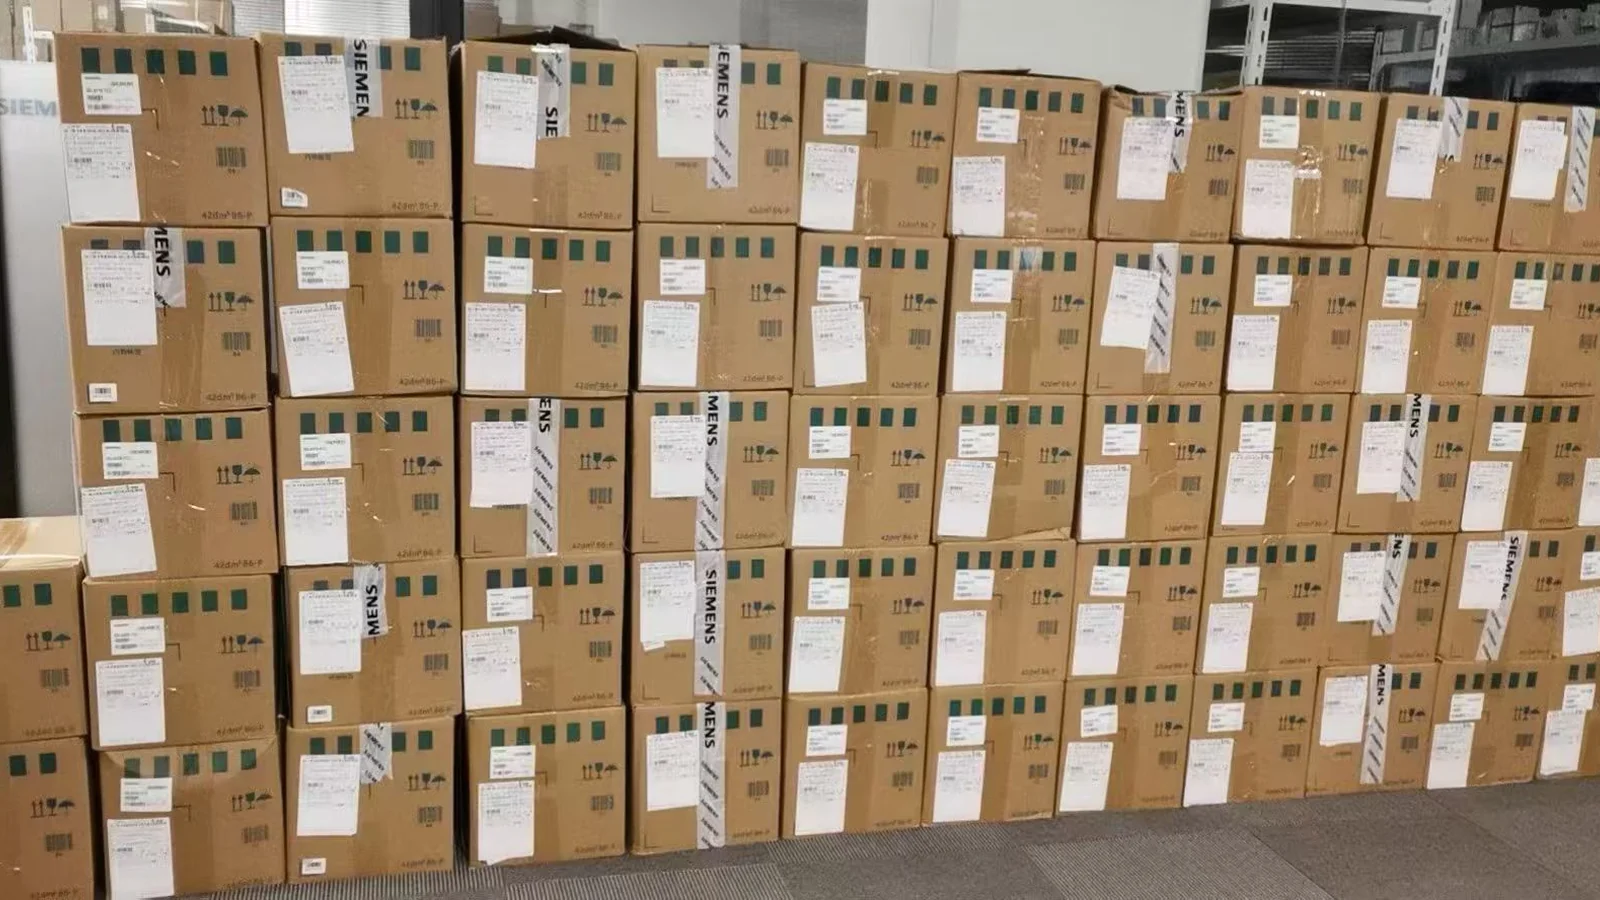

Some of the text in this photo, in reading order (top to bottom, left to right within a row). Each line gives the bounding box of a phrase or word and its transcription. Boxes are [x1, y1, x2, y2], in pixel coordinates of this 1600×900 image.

[545, 106, 559, 137] SIE
[707, 395, 719, 447] MENS
[365, 584, 381, 636] MENS
[705, 569, 718, 645] SIEMENS
[704, 701, 717, 749] MENS
